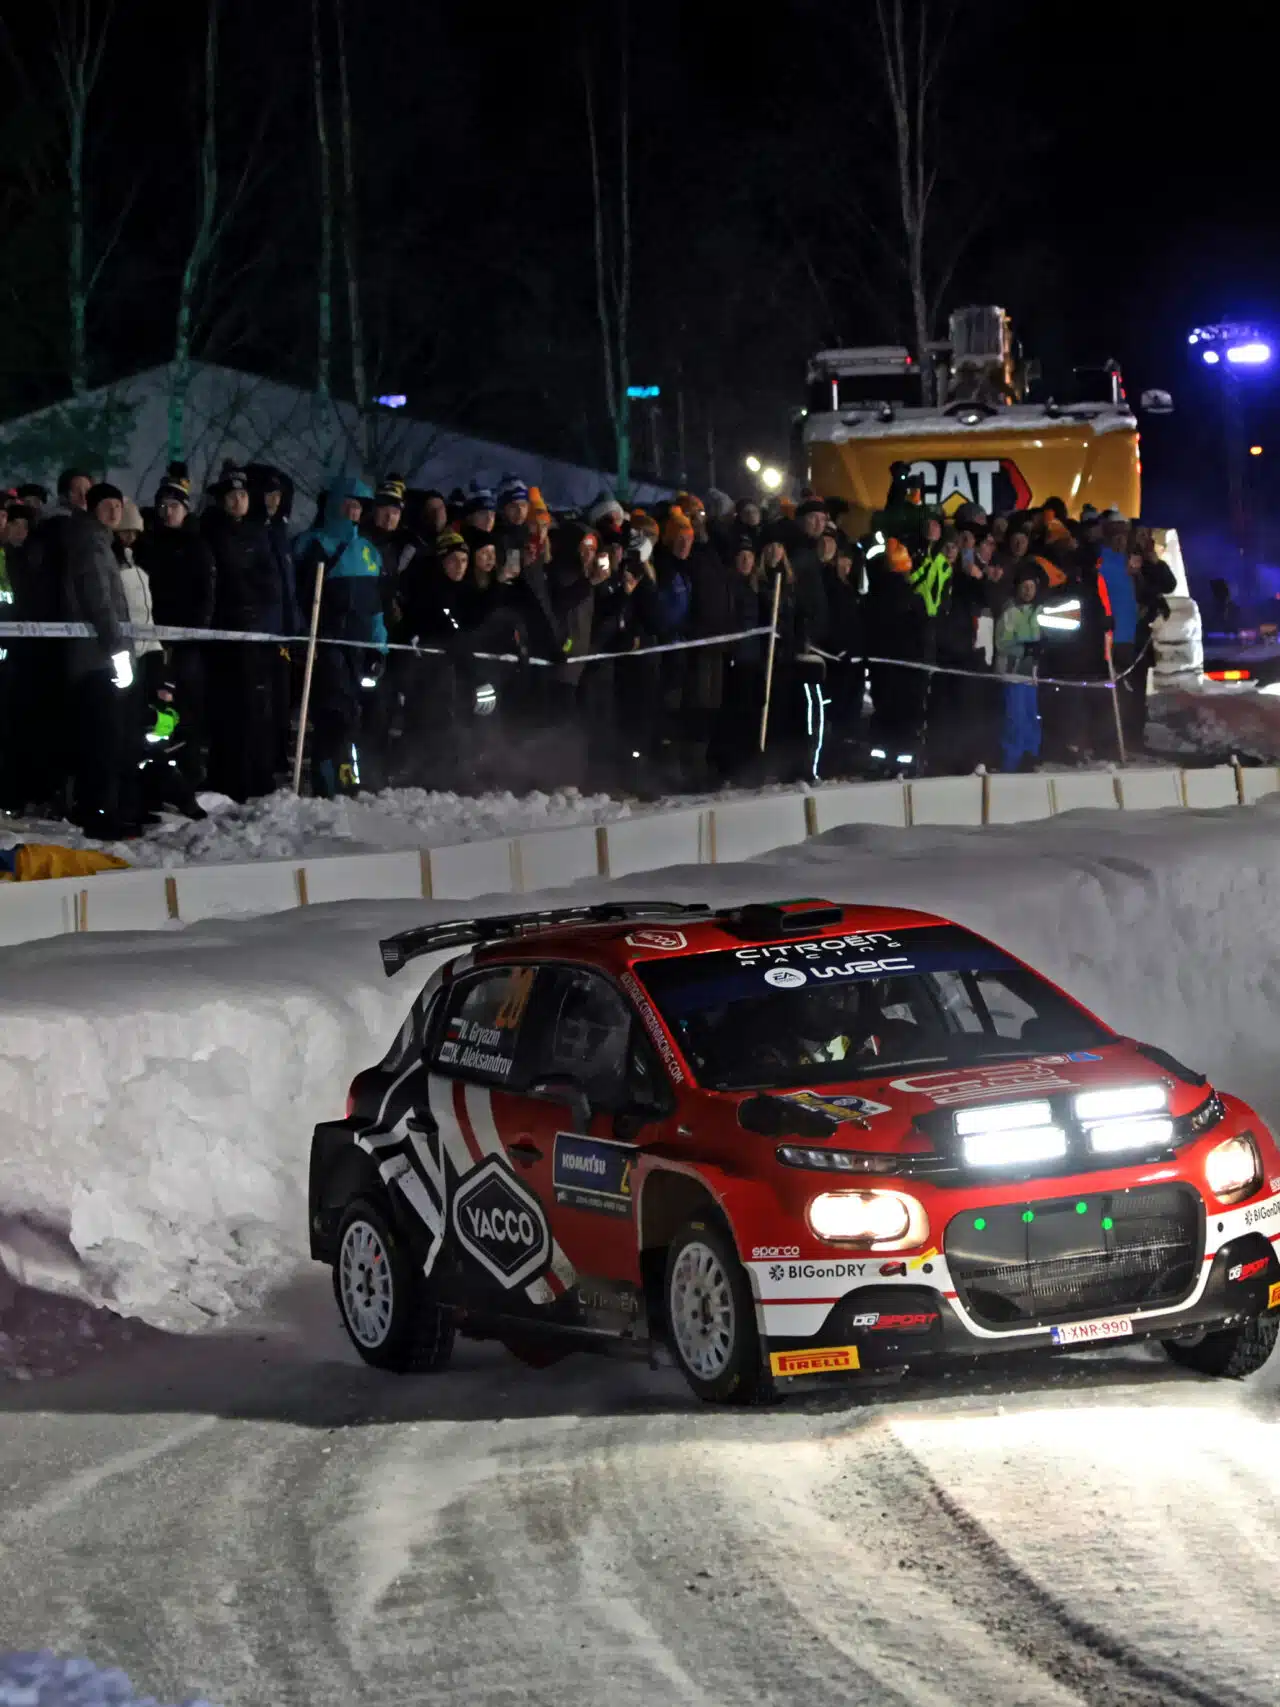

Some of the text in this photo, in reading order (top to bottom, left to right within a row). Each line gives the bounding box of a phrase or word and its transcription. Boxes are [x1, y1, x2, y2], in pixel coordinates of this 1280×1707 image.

[908, 460, 1000, 516] CAT
[735, 933, 893, 960] CITROËN
[809, 957, 915, 979] WRC
[459, 1046, 514, 1077] Aleksandrov
[561, 1153, 607, 1176] KOMATSU
[466, 1206, 535, 1247] YACCO
[751, 1245, 801, 1259] sparco
[788, 1264, 867, 1279] BIGonDRY
[1061, 1320, 1130, 1342] 1-XNR-990
[778, 1350, 850, 1372] PIRELLI
